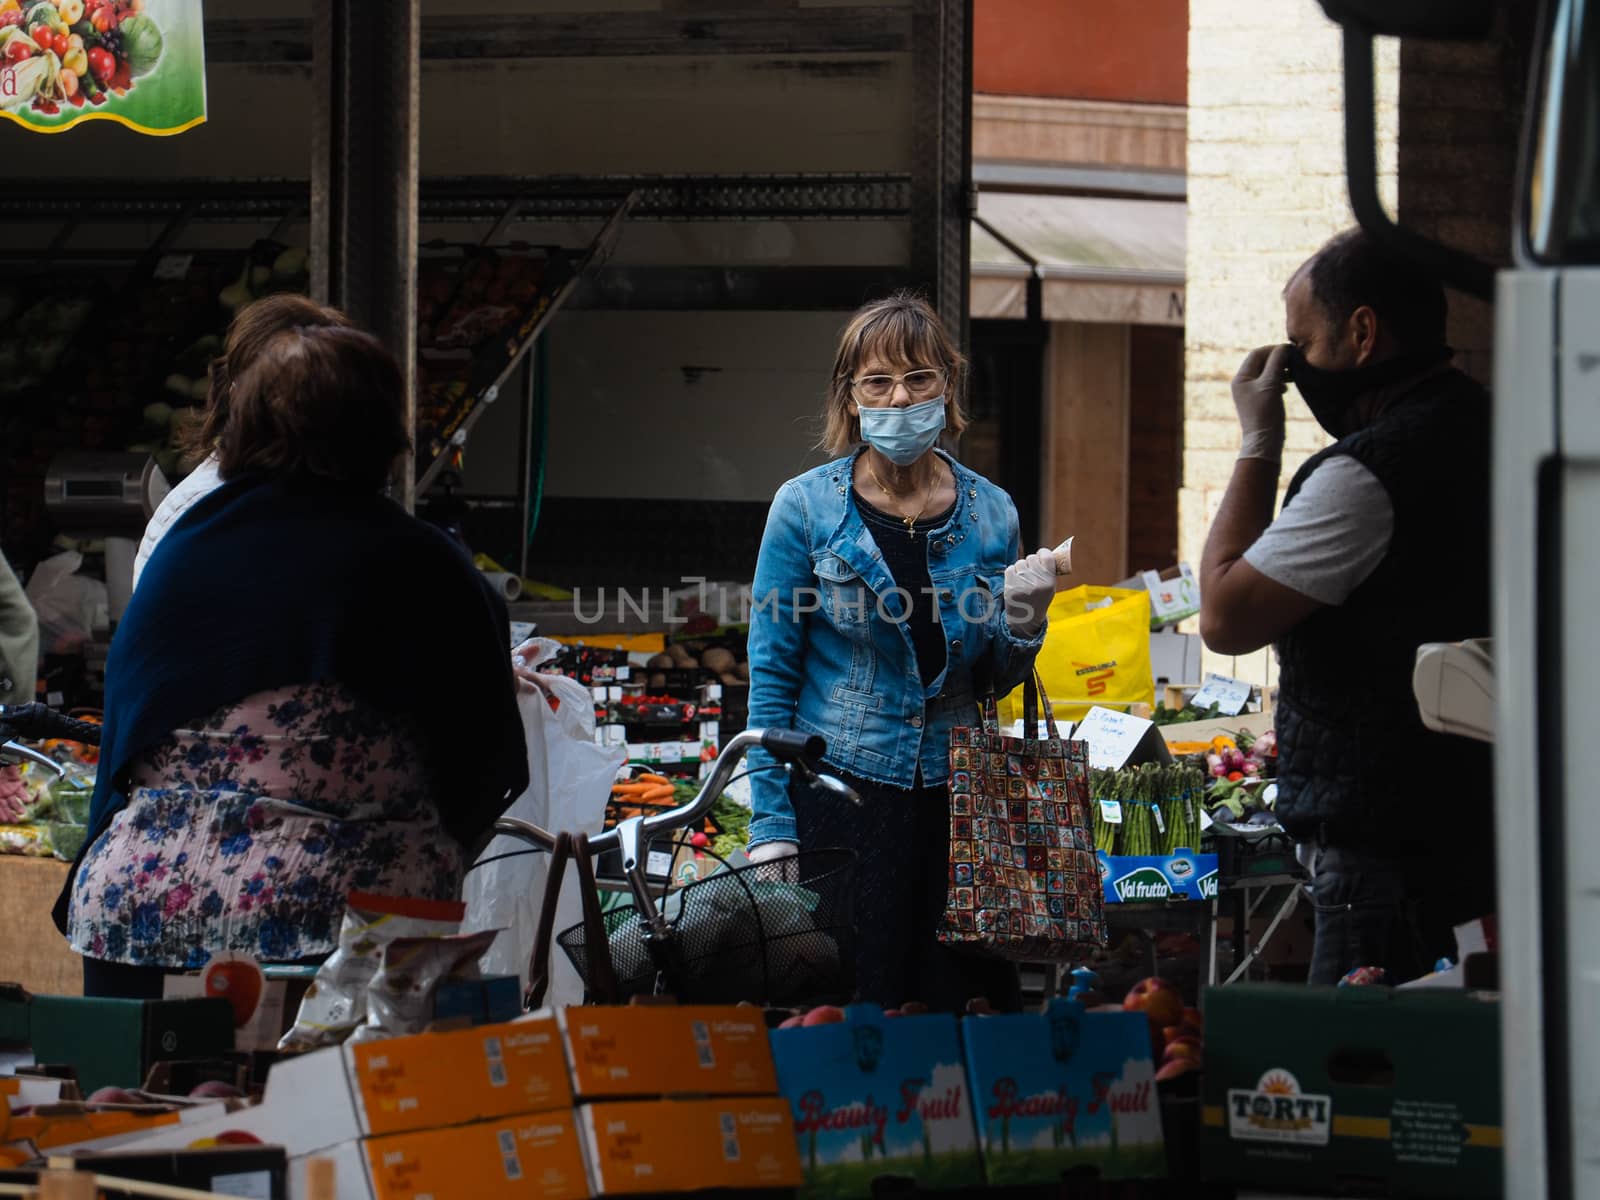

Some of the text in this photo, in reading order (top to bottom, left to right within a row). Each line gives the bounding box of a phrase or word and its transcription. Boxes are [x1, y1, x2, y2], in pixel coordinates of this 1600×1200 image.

[795, 1079, 961, 1144] Beauty Fruit
[988, 1072, 1150, 1133] Beauty Fruit
[1232, 1094, 1326, 1122] TORTI
